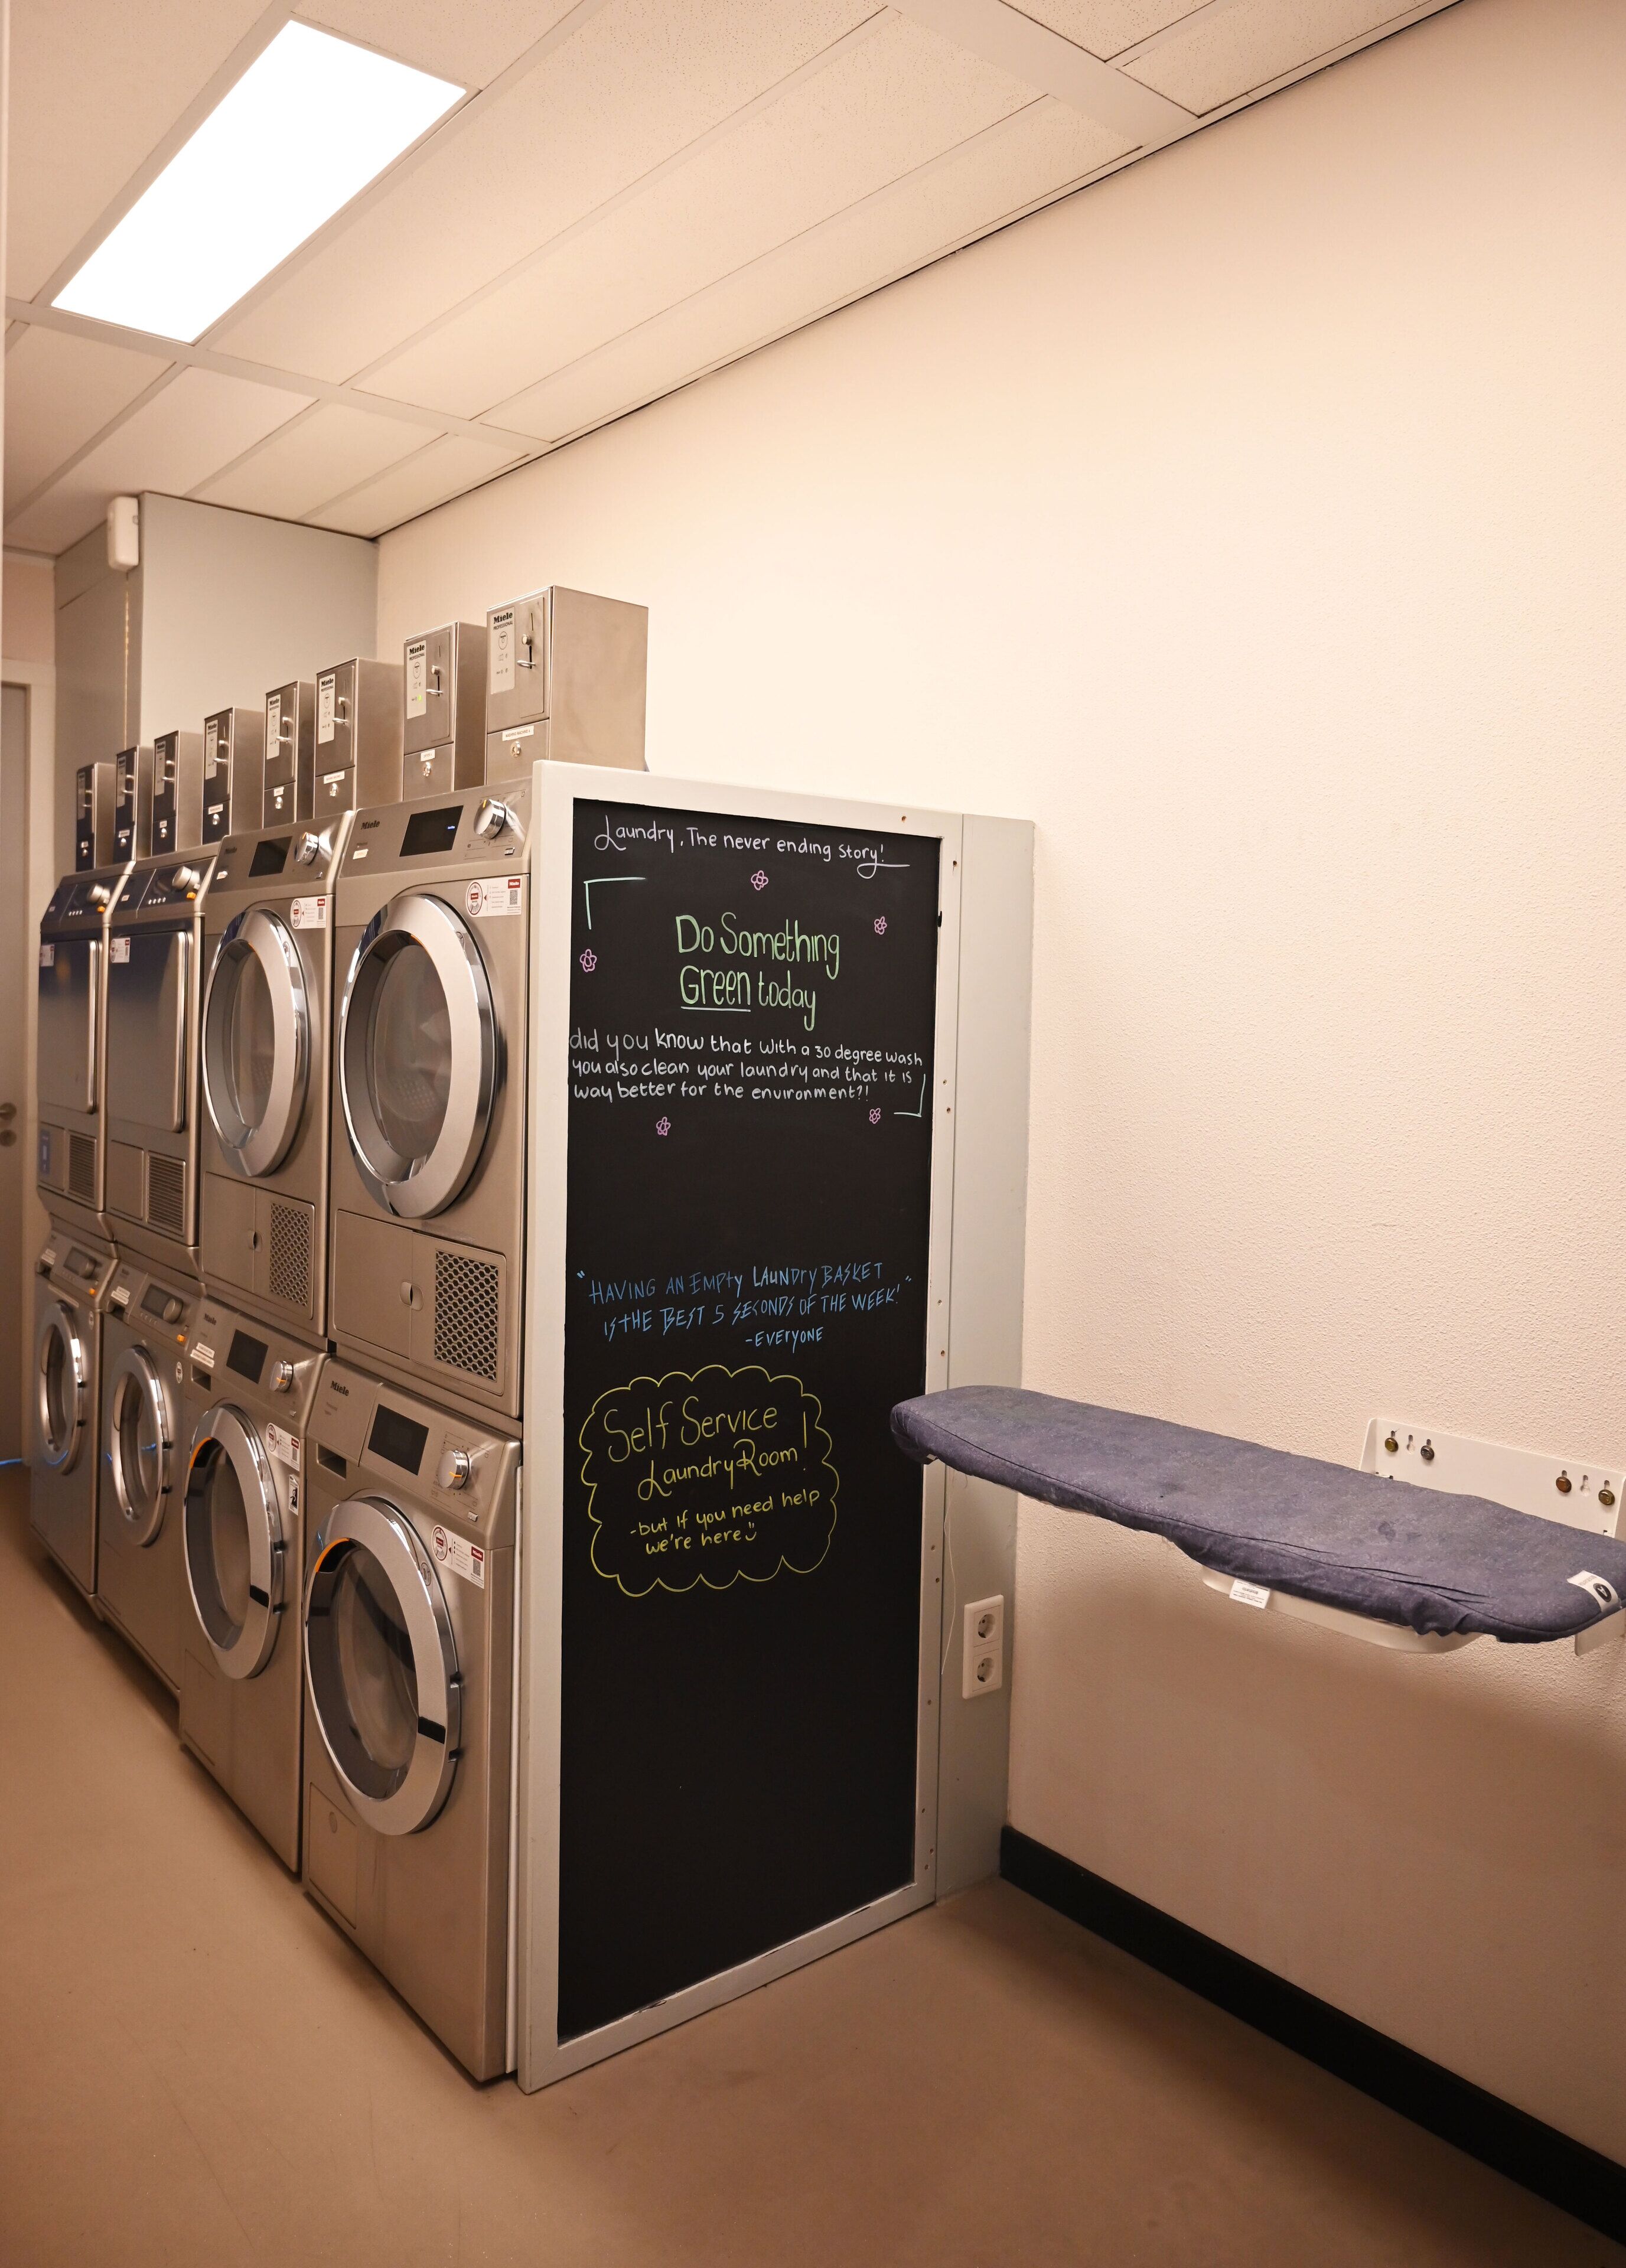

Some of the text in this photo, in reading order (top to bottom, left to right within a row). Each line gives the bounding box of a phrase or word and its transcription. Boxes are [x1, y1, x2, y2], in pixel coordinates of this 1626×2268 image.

[493, 612, 513, 624] Miele
[493, 620, 513, 630] PROFESSIONAL
[409, 646, 425, 655] Miele
[321, 678, 334, 686] Miele
[361, 820, 380, 830] Miele
[686, 827, 717, 847] The
[724, 834, 770, 850] never
[777, 838, 832, 862] ending
[676, 912, 839, 979] Do Something
[680, 966, 816, 1031] Green today
[570, 1027, 598, 1052] did
[607, 1034, 648, 1061] you
[654, 1028, 704, 1049] know
[711, 1035, 751, 1054] that
[801, 1045, 810, 1056] a
[814, 1045, 831, 1058] 30
[835, 1044, 882, 1065] degree
[885, 1051, 923, 1066] wash
[572, 1059, 601, 1077] you
[605, 1060, 638, 1077] also
[641, 1058, 689, 1075] clean
[698, 1064, 734, 1080] your
[741, 1061, 808, 1083] laundry
[812, 1066, 839, 1079] and
[845, 1066, 878, 1082] that
[885, 1070, 895, 1083] it
[574, 1081, 869, 1103] way better for the environment?!
[666, 1276, 684, 1295] AN
[821, 1262, 882, 1289] BASKET
[660, 1305, 705, 1335] BEST
[712, 1305, 724, 1324] 5
[731, 1293, 795, 1325] SECONDS
[799, 1293, 817, 1316] OF
[820, 1293, 847, 1313] THE
[331, 1380, 349, 1396] Miele
[604, 1396, 777, 1462] Self Service
[696, 1510, 726, 1530] you
[732, 1495, 773, 1518] need
[781, 1488, 820, 1507] help
[646, 1529, 742, 1555] we're here
